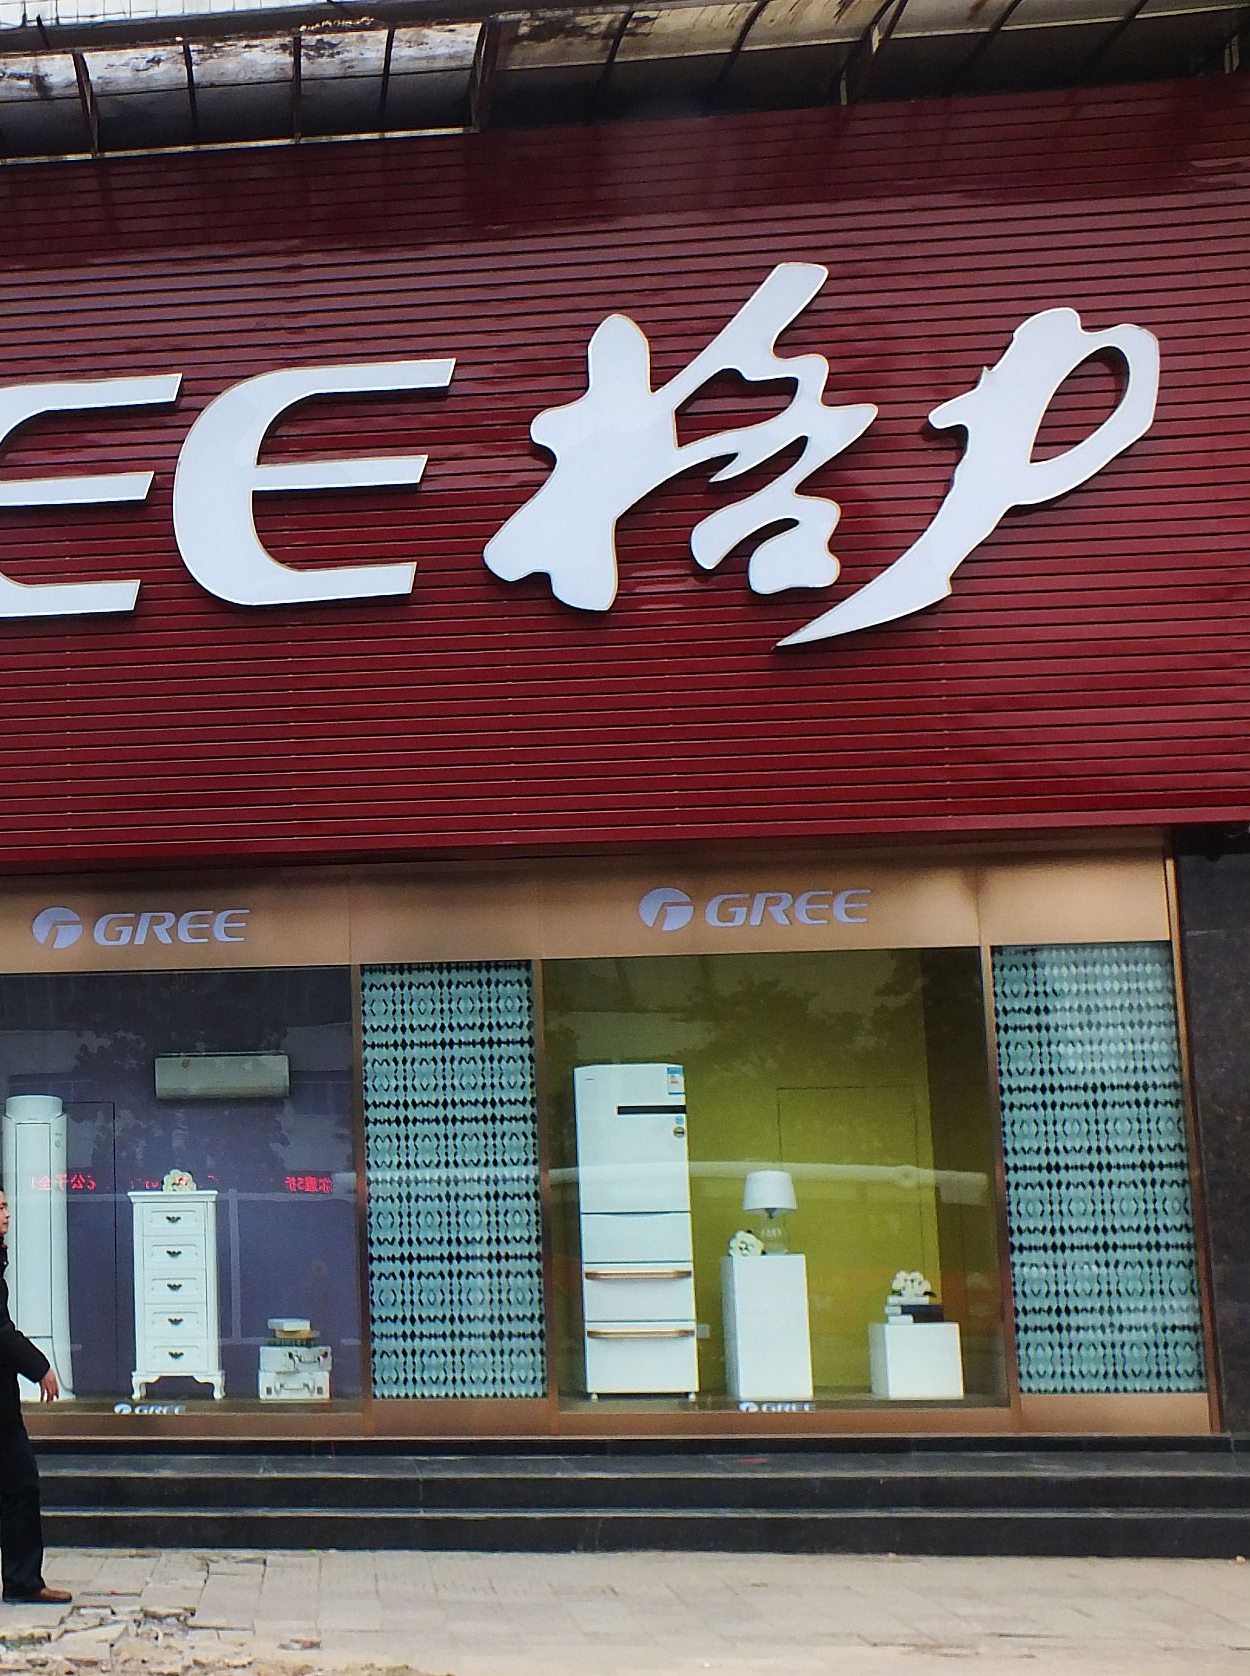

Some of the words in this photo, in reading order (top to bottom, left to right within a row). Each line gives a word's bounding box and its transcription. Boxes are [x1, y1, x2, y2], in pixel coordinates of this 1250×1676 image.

[483, 262, 1160, 646] 格力
[705, 889, 871, 927] GREE
[93, 909, 250, 946] GREE
